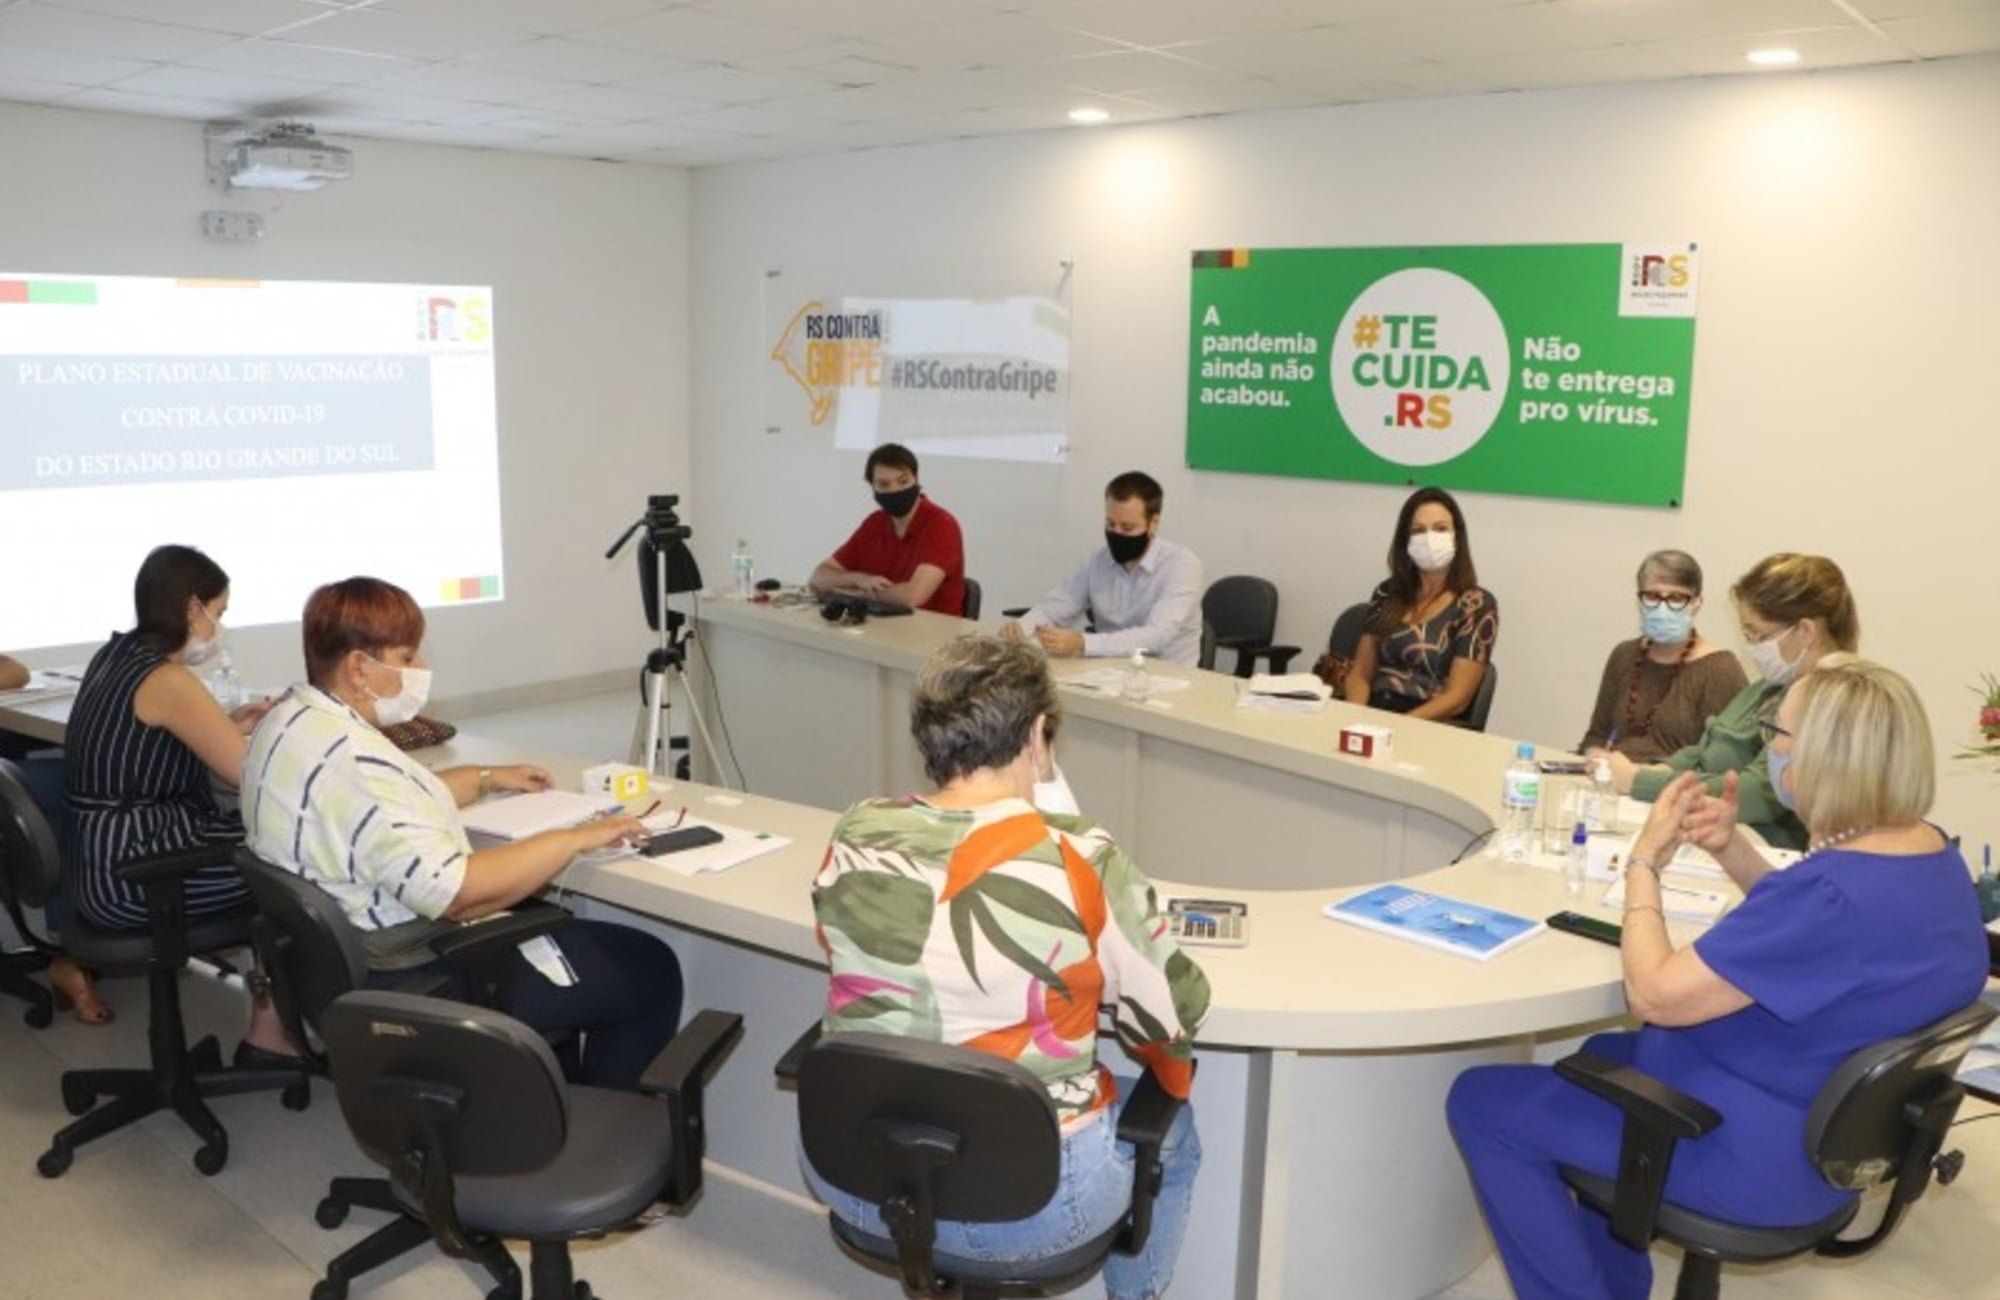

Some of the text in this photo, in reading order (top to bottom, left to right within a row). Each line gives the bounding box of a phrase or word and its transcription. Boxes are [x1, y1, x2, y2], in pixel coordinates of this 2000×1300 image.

[806, 315, 880, 338] RS CONTRA
[1203, 304, 1220, 326] A
[1202, 331, 1318, 356] pandemia
[1353, 314, 1437, 349] #TE
[1523, 335, 1581, 361] Não
[18, 356, 404, 386] PLANO ESTADUAL DE VACINAÇÃO
[892, 361, 1057, 398] #RSContraGripe
[1201, 357, 1313, 380] ainda não
[1352, 353, 1491, 391] CUIDA
[1200, 384, 1291, 407] acabou.
[1521, 367, 1674, 399] te entrega
[121, 404, 326, 429] CONTRA COVID-19
[1384, 392, 1452, 429] .RS
[1519, 398, 1659, 426] pro vírus.
[36, 443, 400, 477] DO ESTADO RIO GRANDE DO SUL
